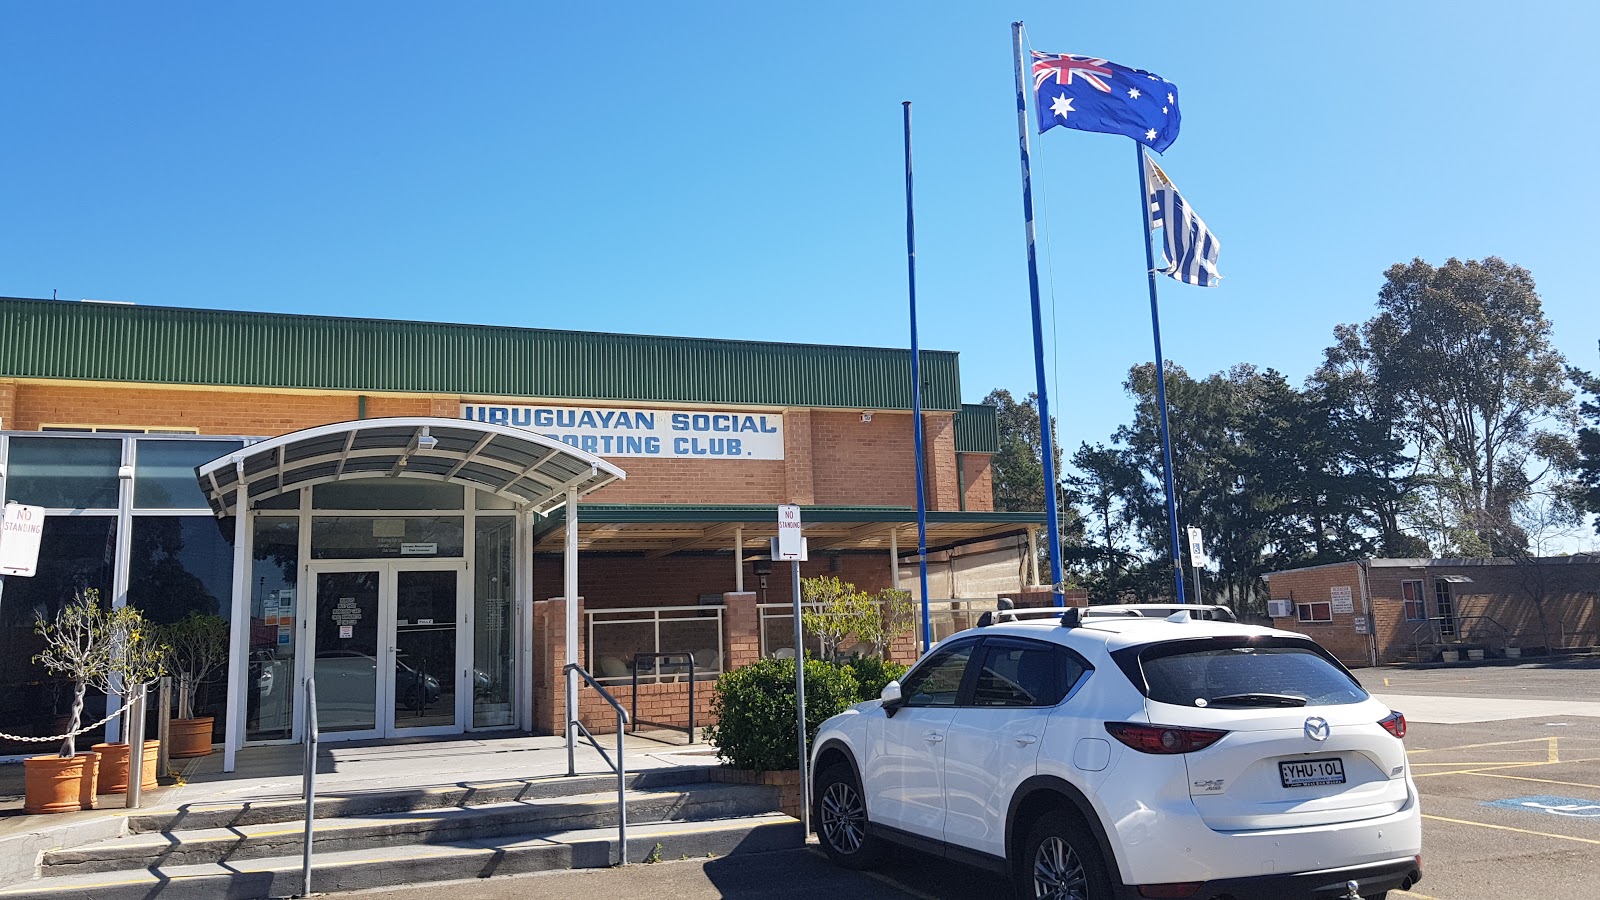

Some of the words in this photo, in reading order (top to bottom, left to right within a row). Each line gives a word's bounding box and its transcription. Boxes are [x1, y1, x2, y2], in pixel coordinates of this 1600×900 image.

[465, 406, 655, 430] URUGUAYAN
[671, 413, 777, 434] SOCIAL
[673, 437, 752, 456] CLUB.
[16, 509, 32, 521] NO
[785, 510, 794, 520] NO
[4, 521, 41, 534] STANDING
[779, 521, 801, 529] STANDING
